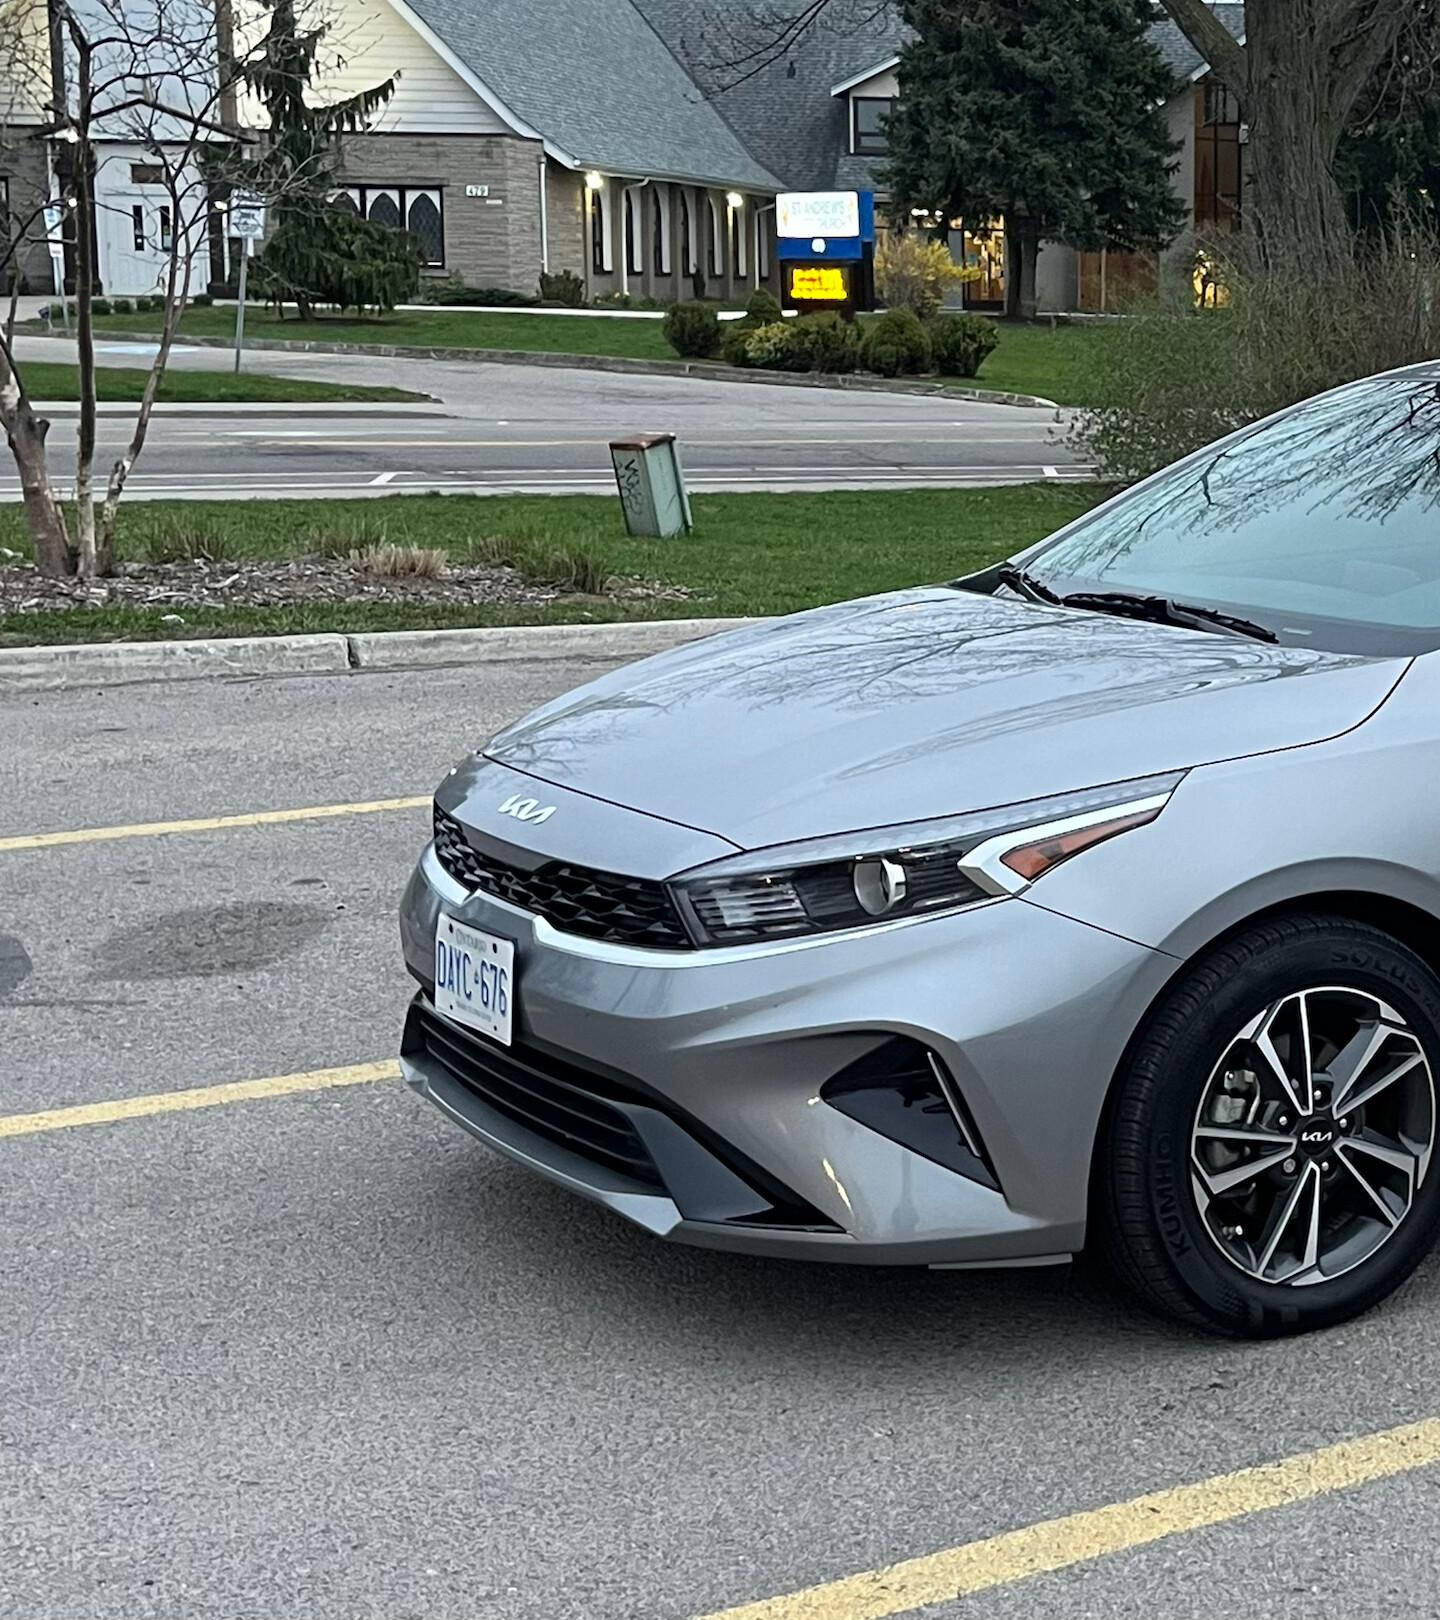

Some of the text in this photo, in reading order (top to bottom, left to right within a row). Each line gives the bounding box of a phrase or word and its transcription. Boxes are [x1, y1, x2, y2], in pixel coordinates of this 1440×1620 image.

[468, 185, 486, 197] 479
[498, 794, 557, 824] KIA
[1331, 950, 1422, 993] SOLUS
[1156, 1133, 1192, 1258] KUMHO
